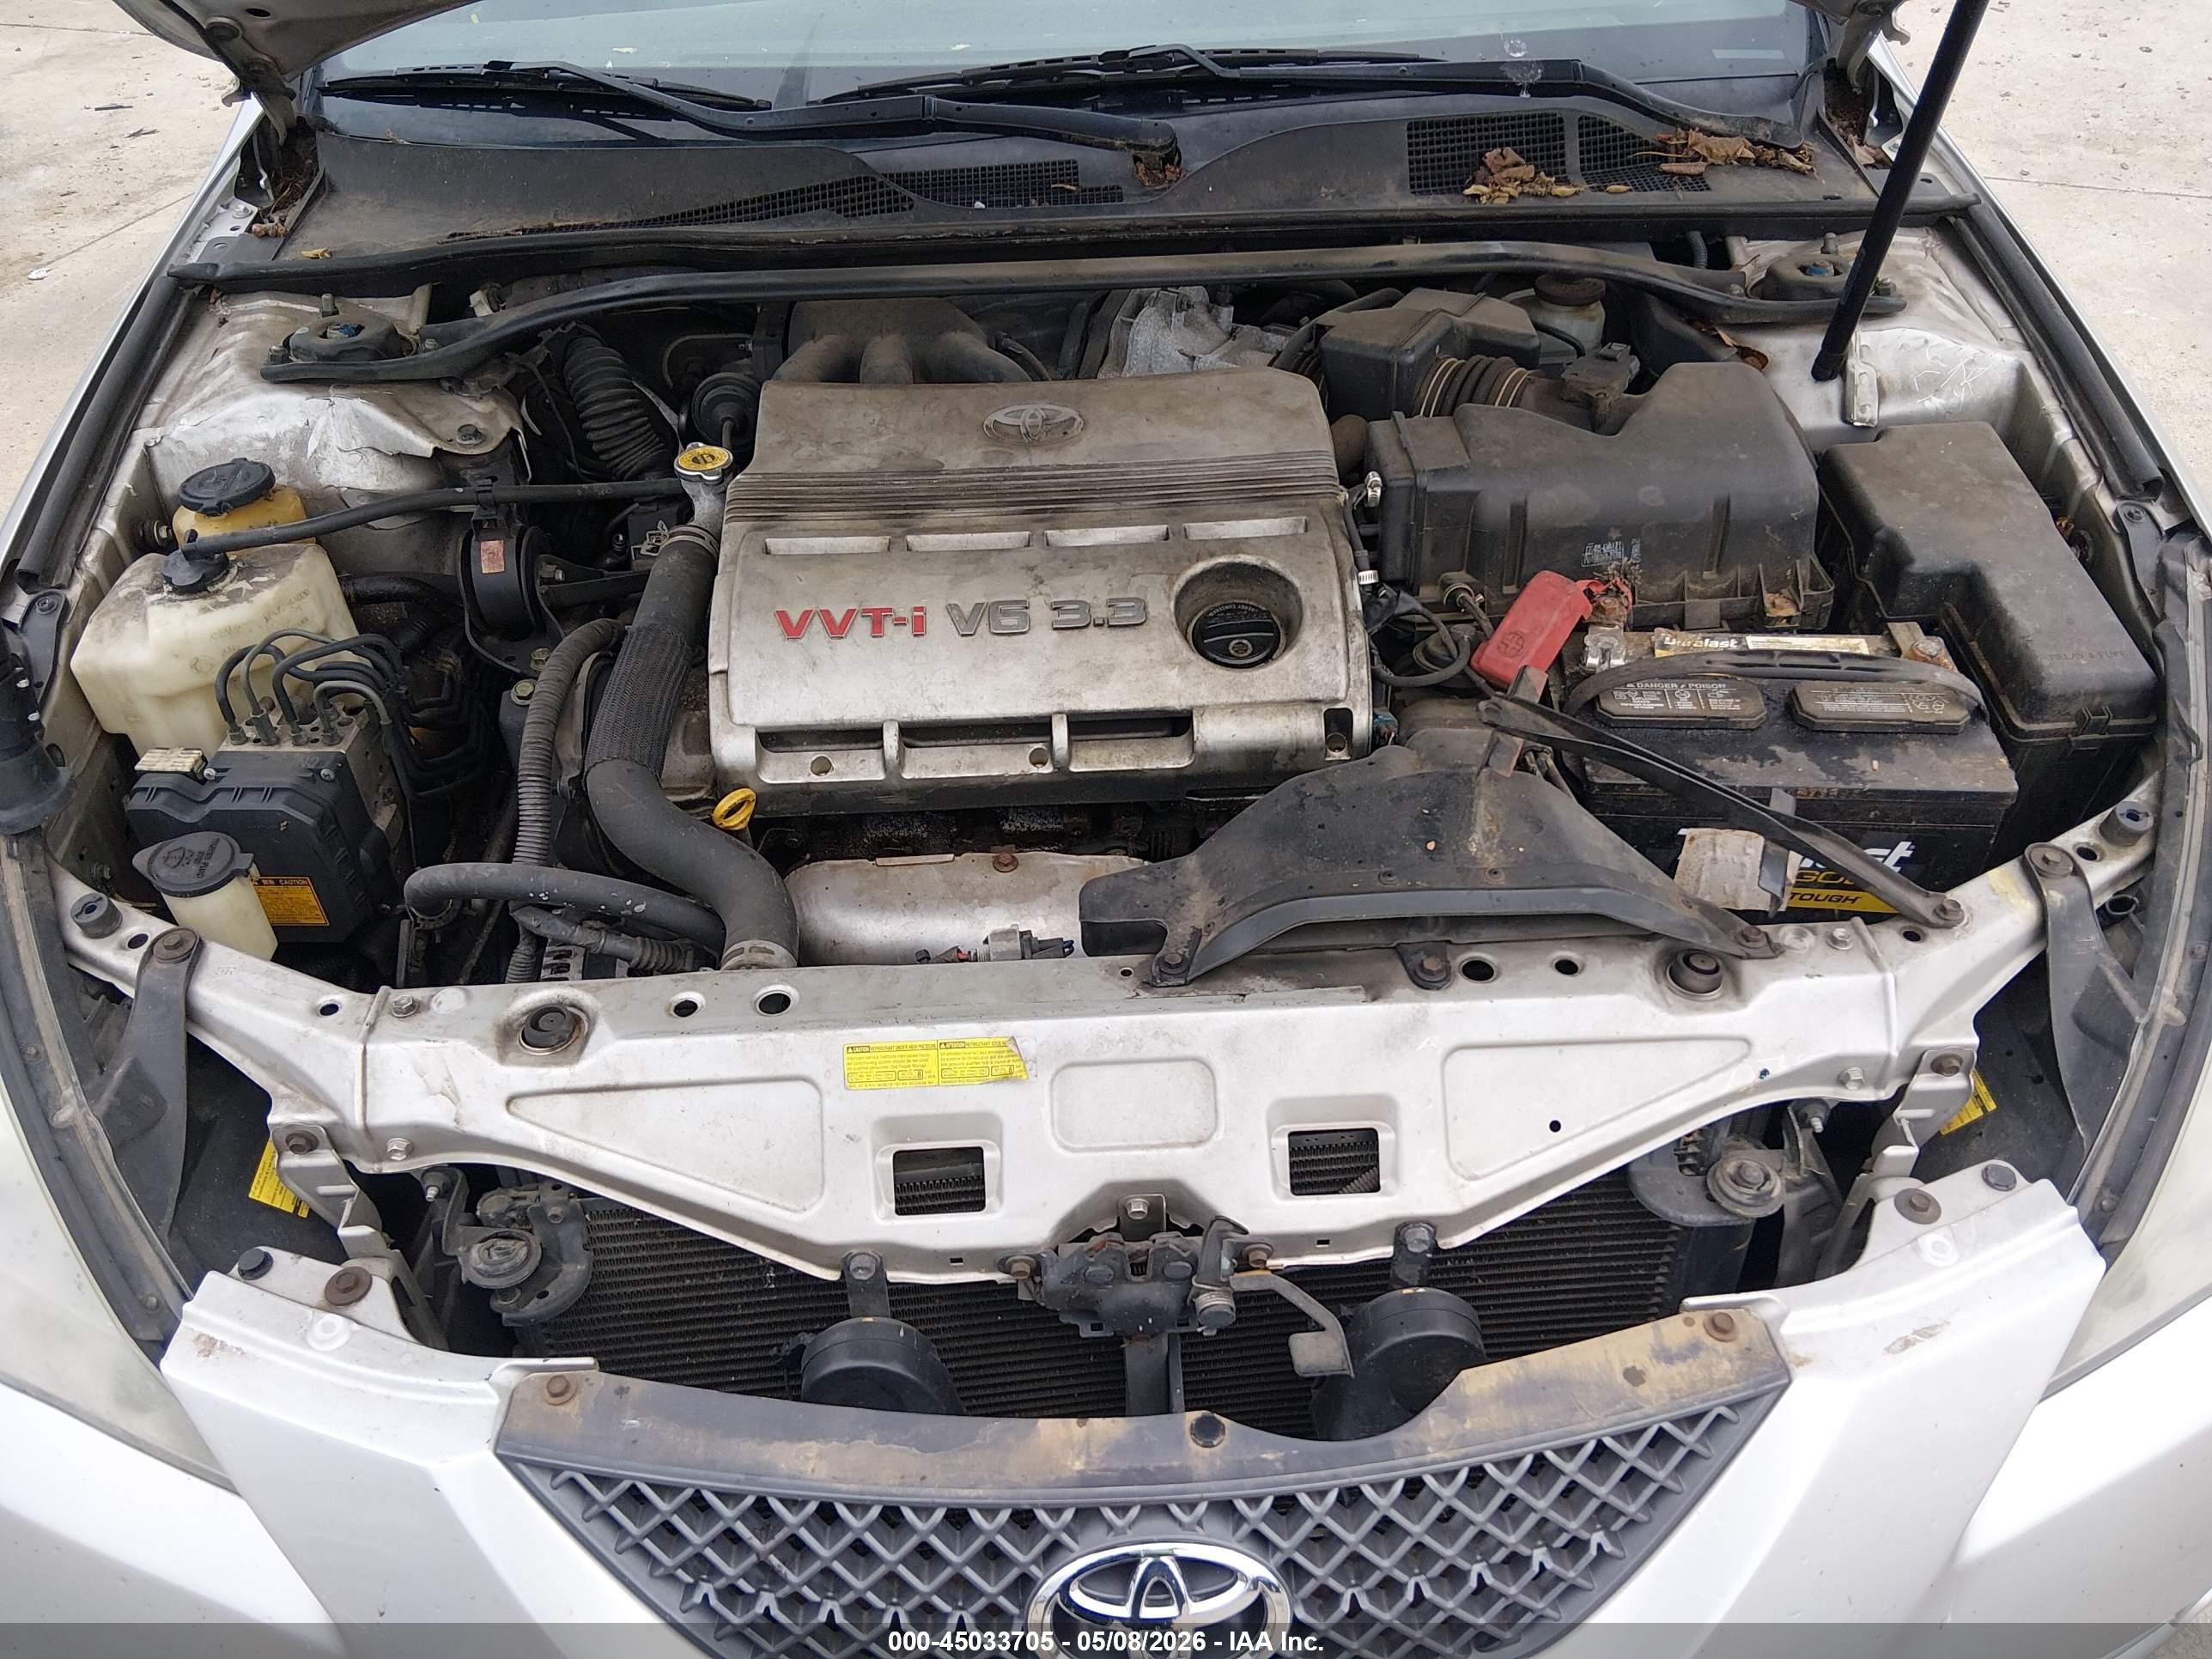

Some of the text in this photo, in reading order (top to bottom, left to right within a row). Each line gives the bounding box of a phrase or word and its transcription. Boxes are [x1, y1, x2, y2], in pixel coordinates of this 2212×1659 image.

[775, 597, 1148, 641] VVT-i V6 3.3
[1790, 891, 1859, 904] TOUGH
